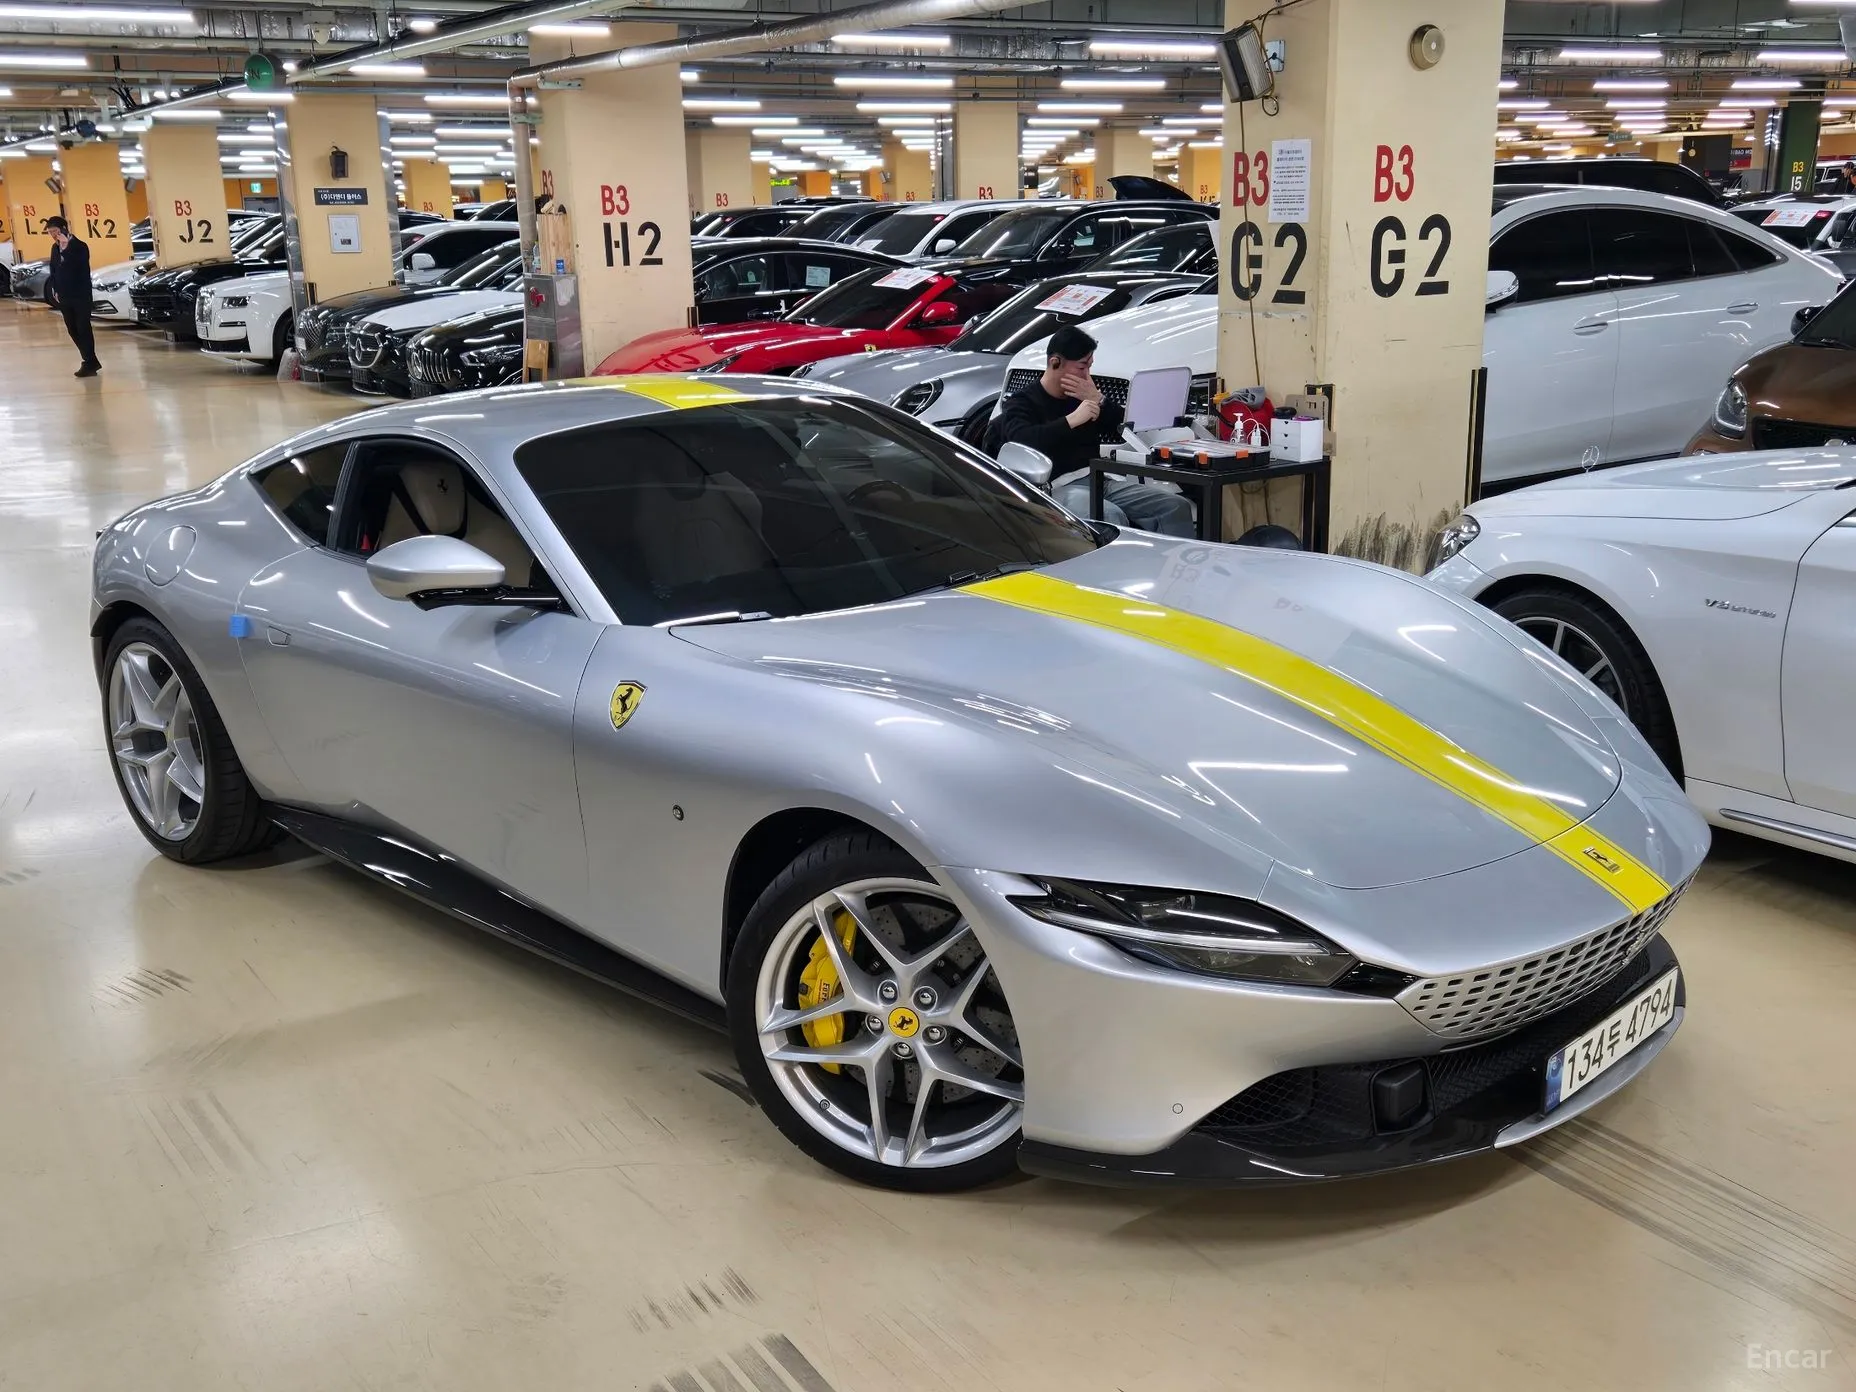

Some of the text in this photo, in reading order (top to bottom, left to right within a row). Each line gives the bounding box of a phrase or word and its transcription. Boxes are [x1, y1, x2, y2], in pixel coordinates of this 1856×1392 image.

[1374, 144, 1415, 203] B3
[1792, 161, 1804, 173] B3
[542, 169, 554, 200] B3
[1233, 150, 1270, 207] B3
[600, 185, 630, 216] B3
[716, 193, 729, 207] B3
[979, 187, 994, 200] B3
[1096, 186, 1104, 198] B3
[23, 205, 36, 217] B3
[84, 203, 100, 217] B3
[174, 200, 192, 216] B3
[423, 201, 434, 212] B3
[86, 218, 117, 239] K2
[179, 219, 214, 243] J2
[603, 221, 663, 267] H2
[1230, 220, 1308, 305] G2
[1370, 213, 1452, 299] G2
[1705, 598, 1730, 610] V8
[1567, 978, 1673, 1089] 134두 4794
